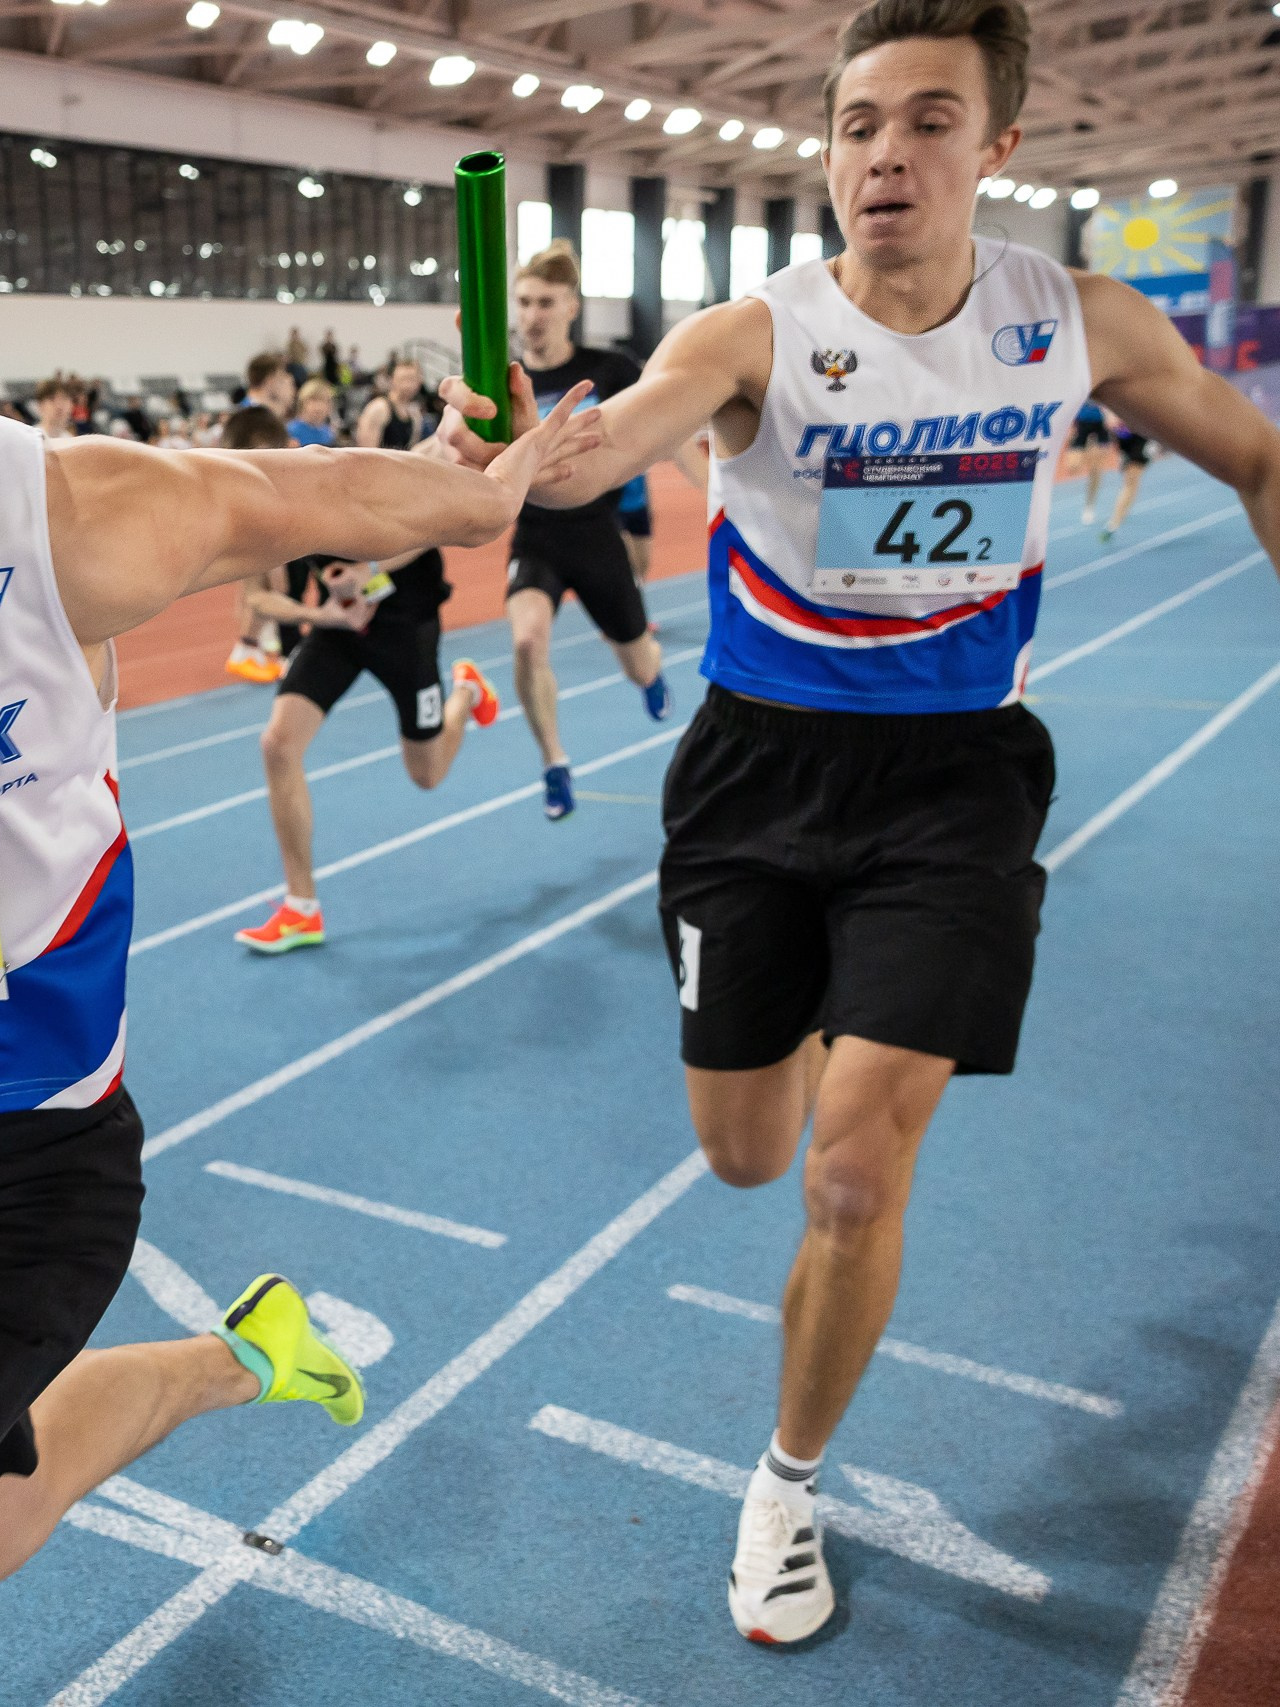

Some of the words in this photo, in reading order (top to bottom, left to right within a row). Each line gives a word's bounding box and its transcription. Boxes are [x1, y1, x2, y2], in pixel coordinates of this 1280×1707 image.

[795, 401, 1062, 458] ГЦОЛИФК
[958, 453, 1019, 472] 2025
[874, 499, 972, 564] 42
